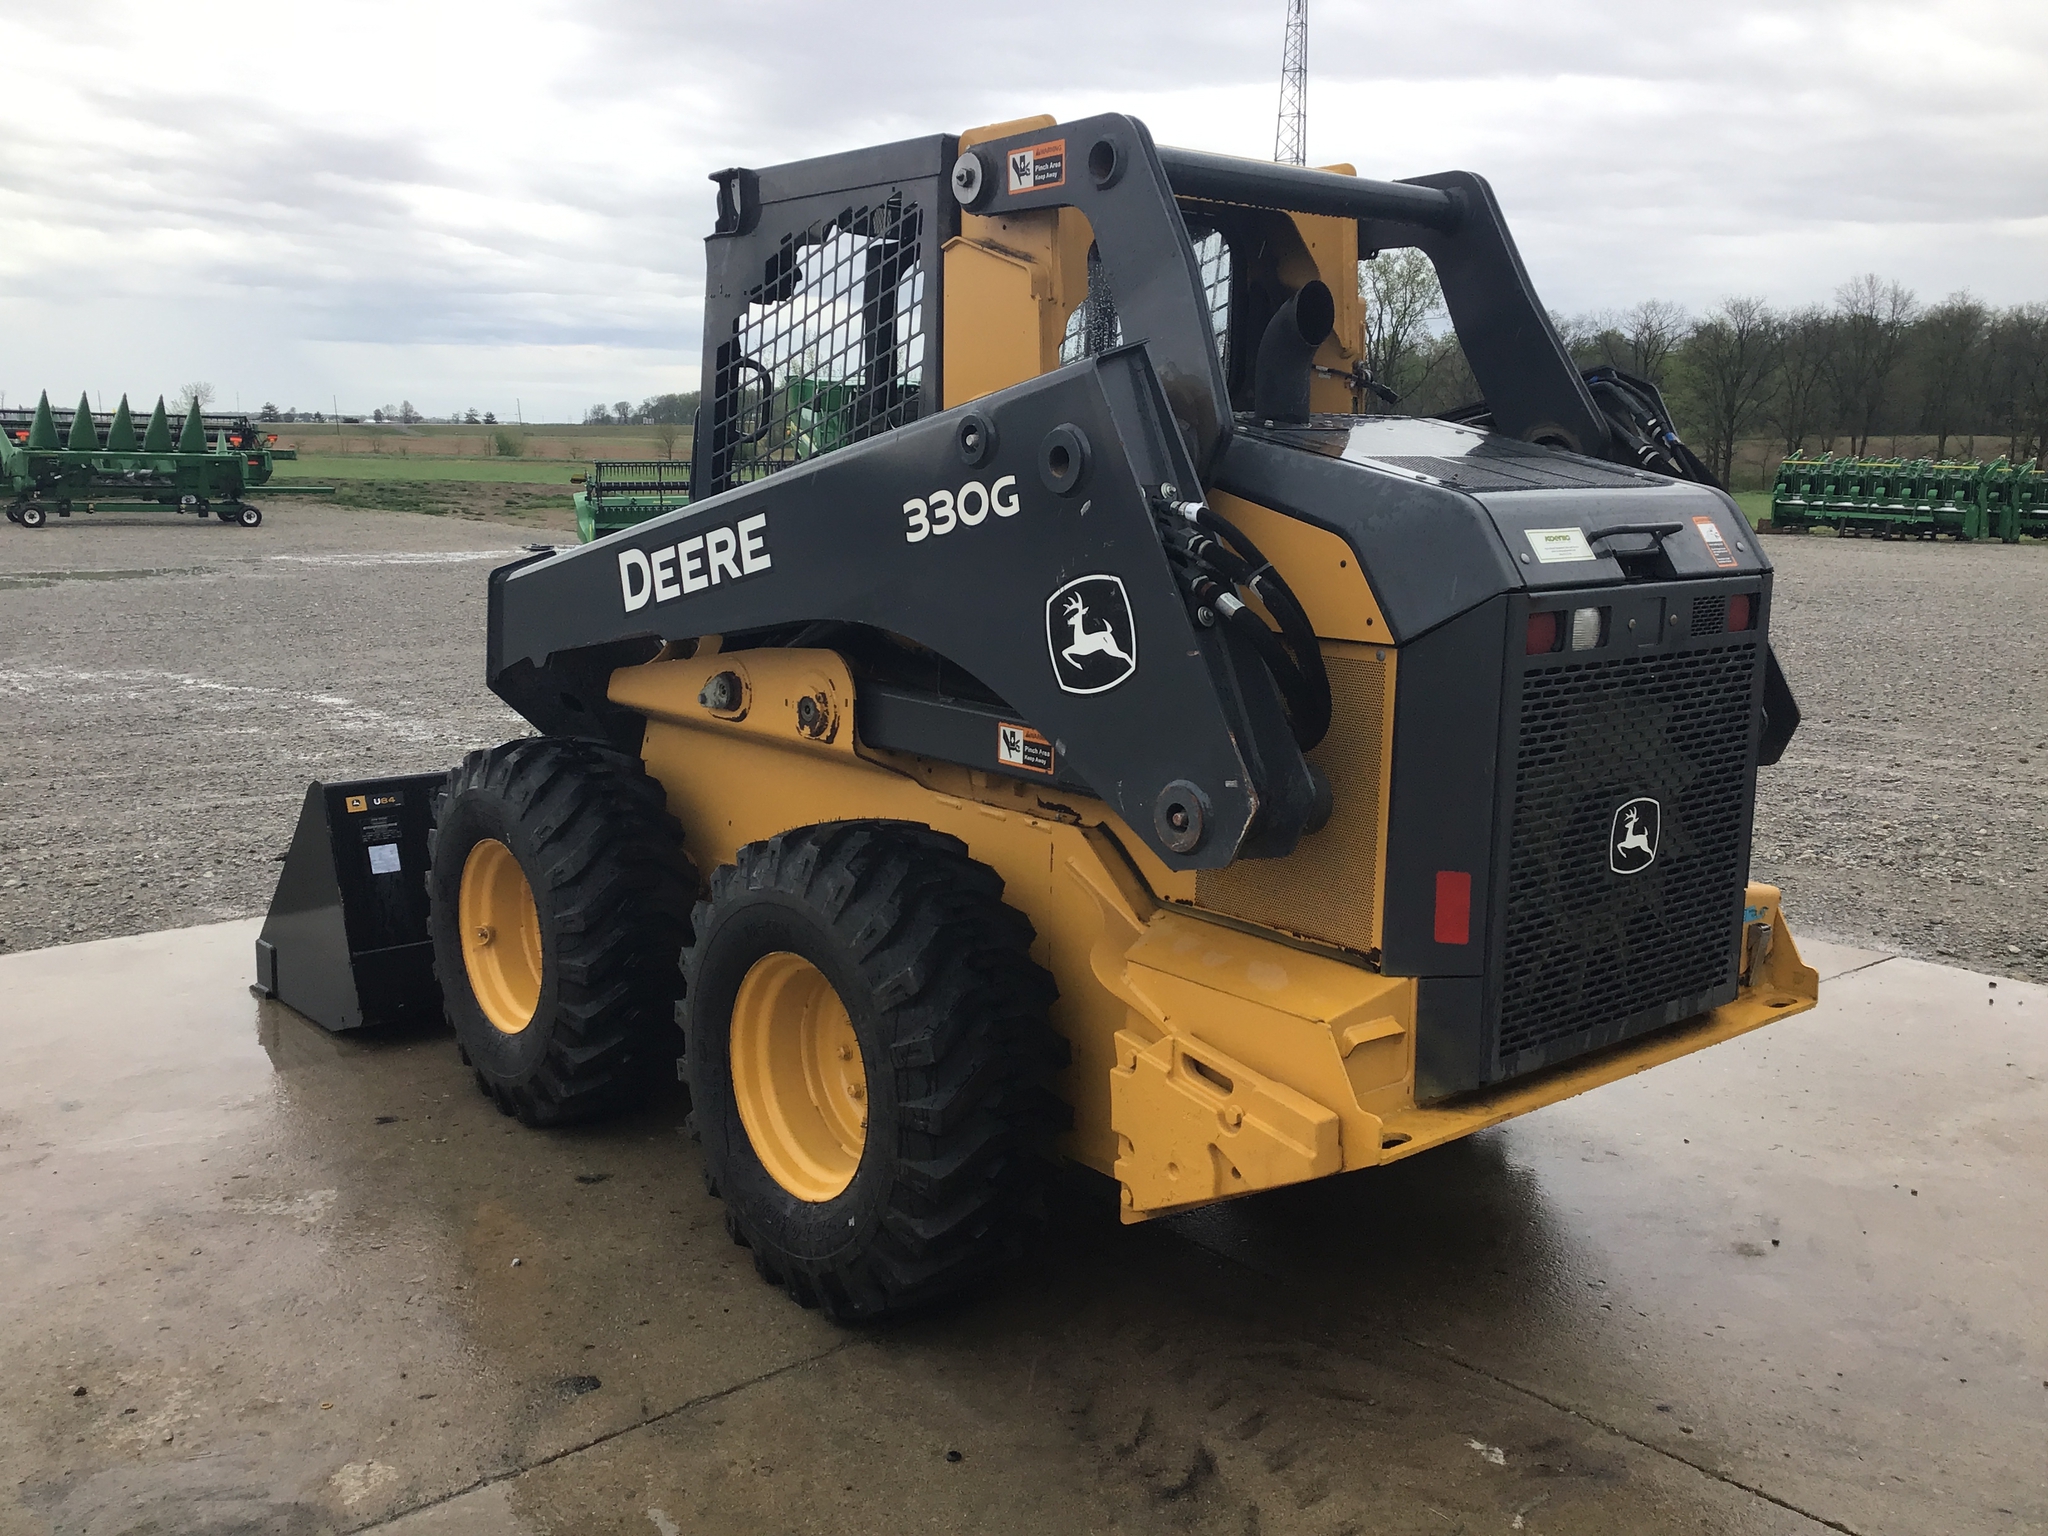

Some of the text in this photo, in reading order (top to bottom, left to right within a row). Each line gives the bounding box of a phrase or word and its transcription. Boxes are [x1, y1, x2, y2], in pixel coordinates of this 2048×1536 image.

[1035, 163, 1049, 172] Pinch
[1035, 173, 1046, 181] Keep
[902, 475, 1020, 543] 330G
[618, 513, 772, 612] DEERE
[1025, 746, 1050, 757] Pinch Area
[1035, 757, 1046, 765] Away
